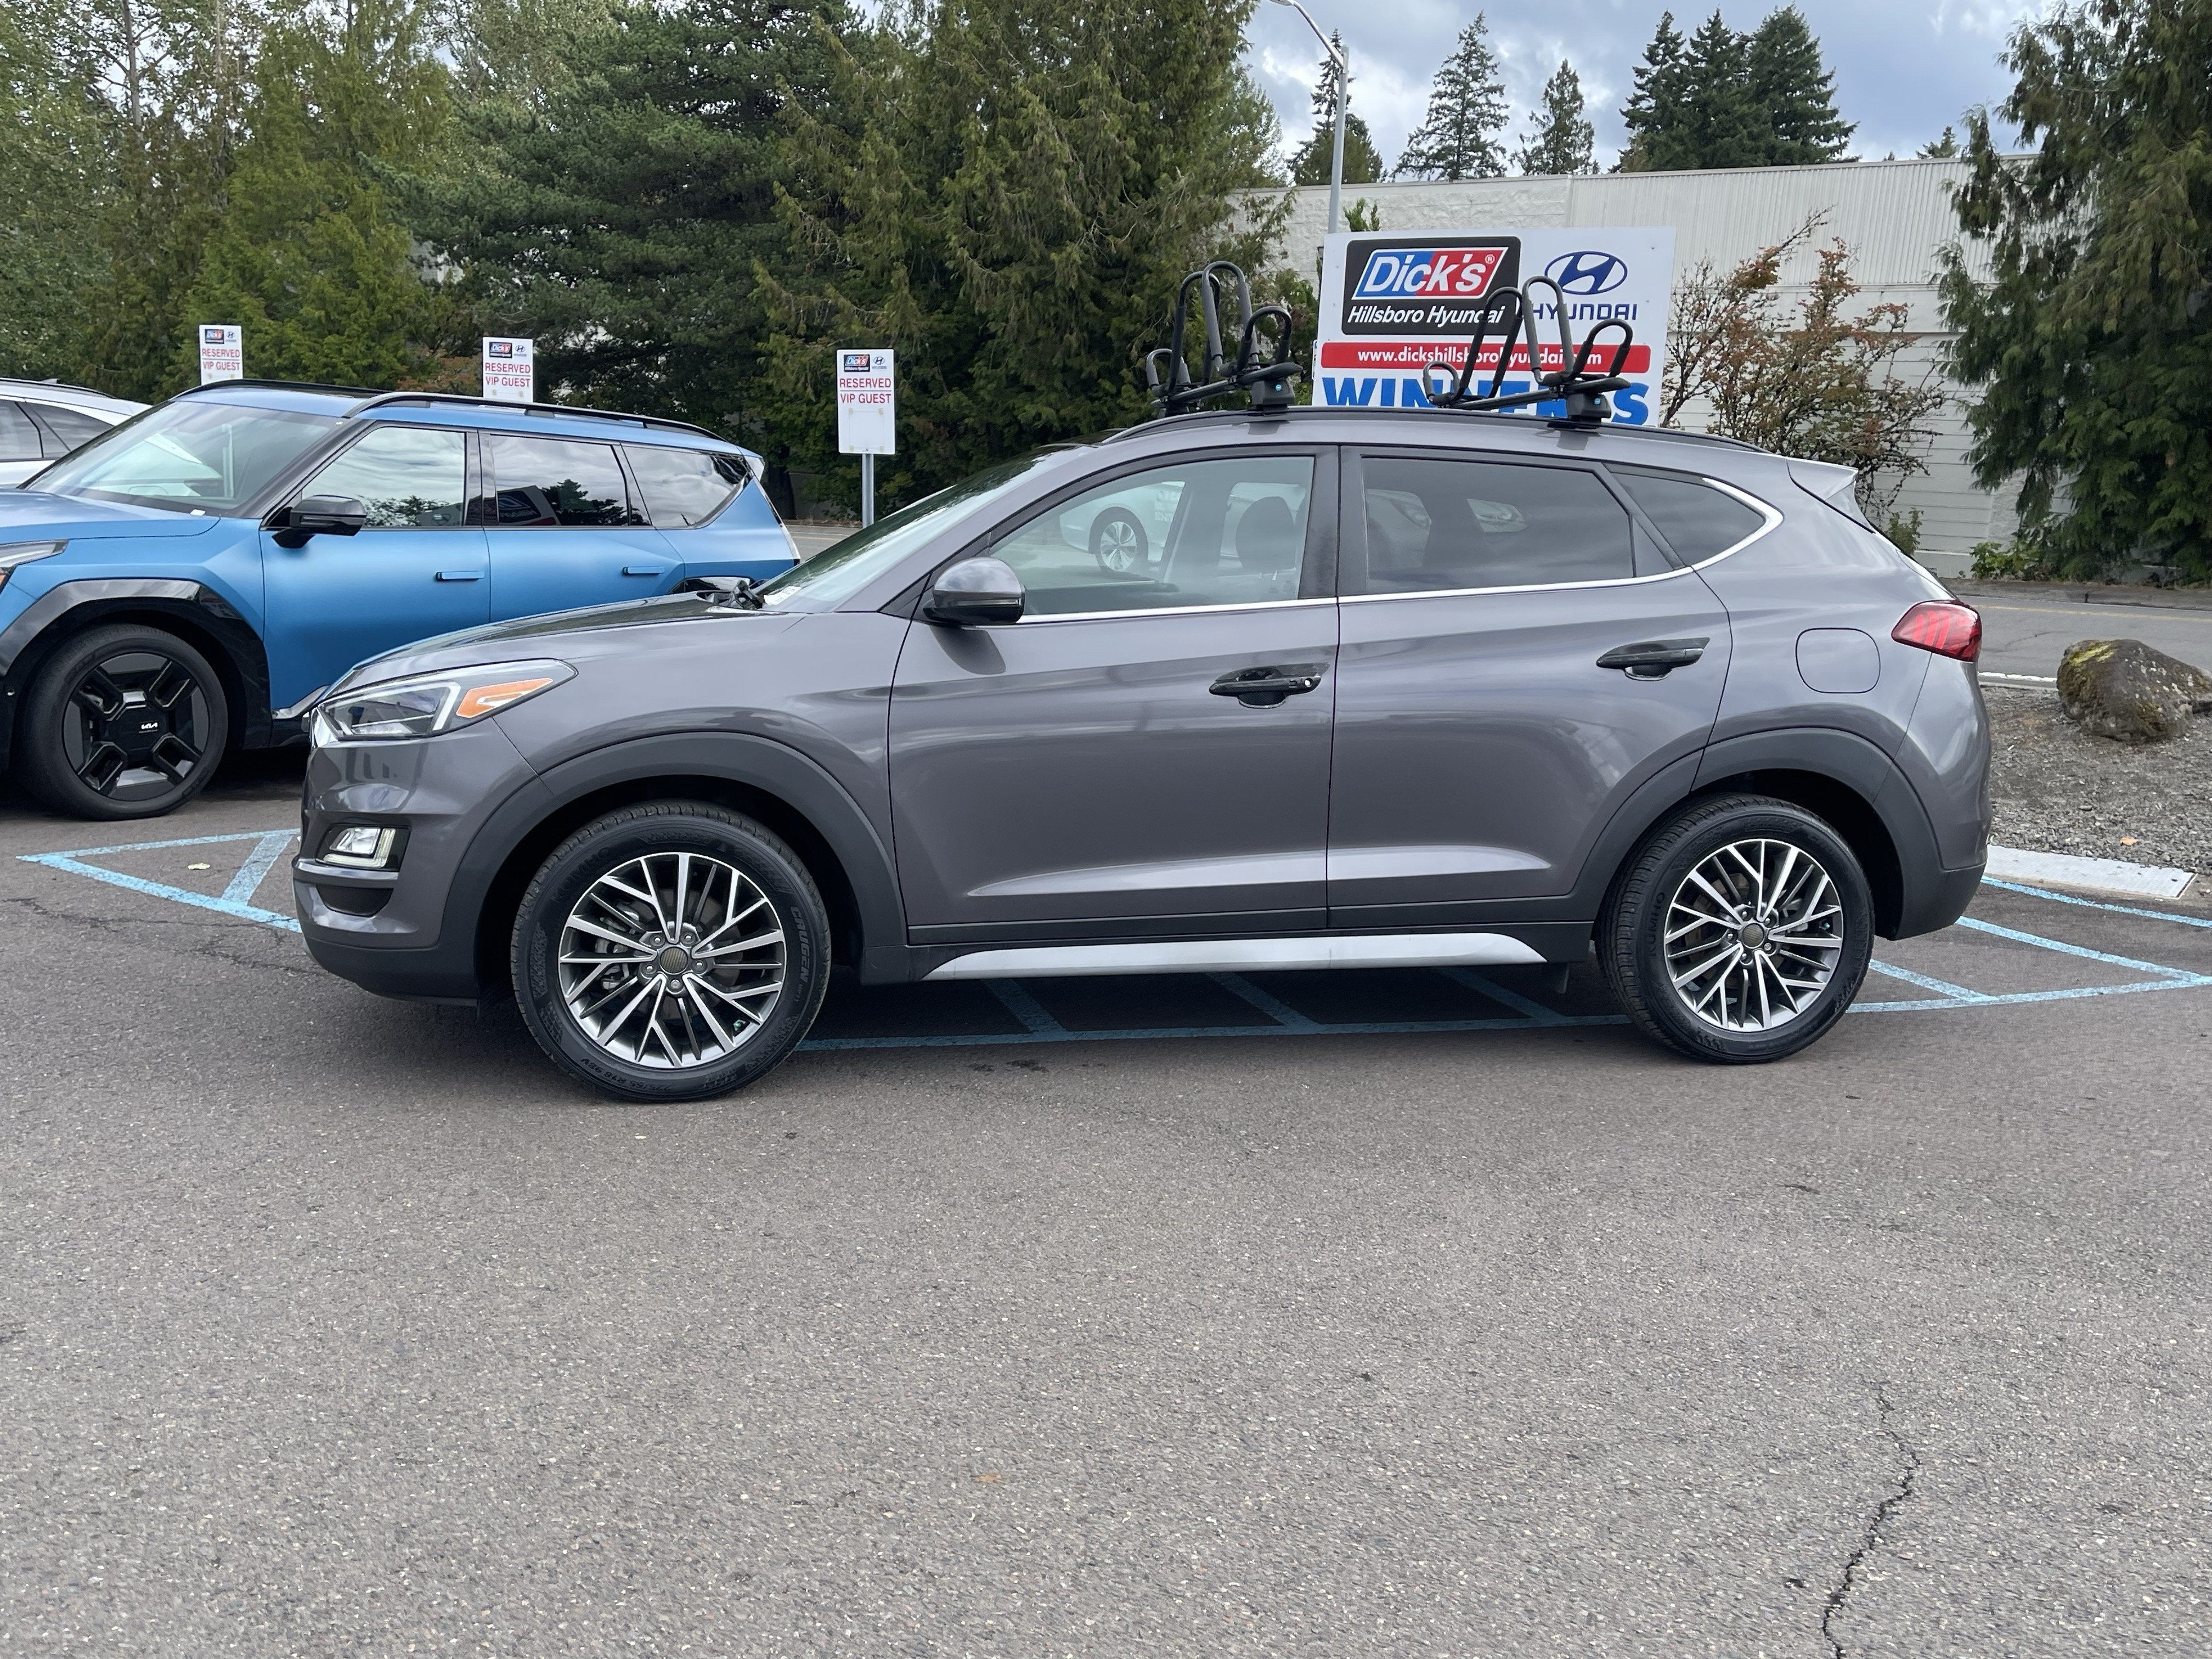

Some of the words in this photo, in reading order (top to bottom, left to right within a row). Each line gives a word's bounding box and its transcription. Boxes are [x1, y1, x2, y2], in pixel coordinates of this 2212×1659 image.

[1363, 253, 1486, 292] Dick's
[1347, 306, 1424, 324] Hillsboro
[202, 348, 240, 358] RESERVED
[216, 362, 240, 370] GUEST
[485, 363, 531, 373] RESERVED
[486, 376, 499, 385] VIP
[501, 377, 531, 387] GUEST
[839, 378, 891, 388] RESERVED
[840, 393, 855, 403] VIP
[859, 393, 891, 403] GUEST
[790, 906, 811, 983] CRUGEN
